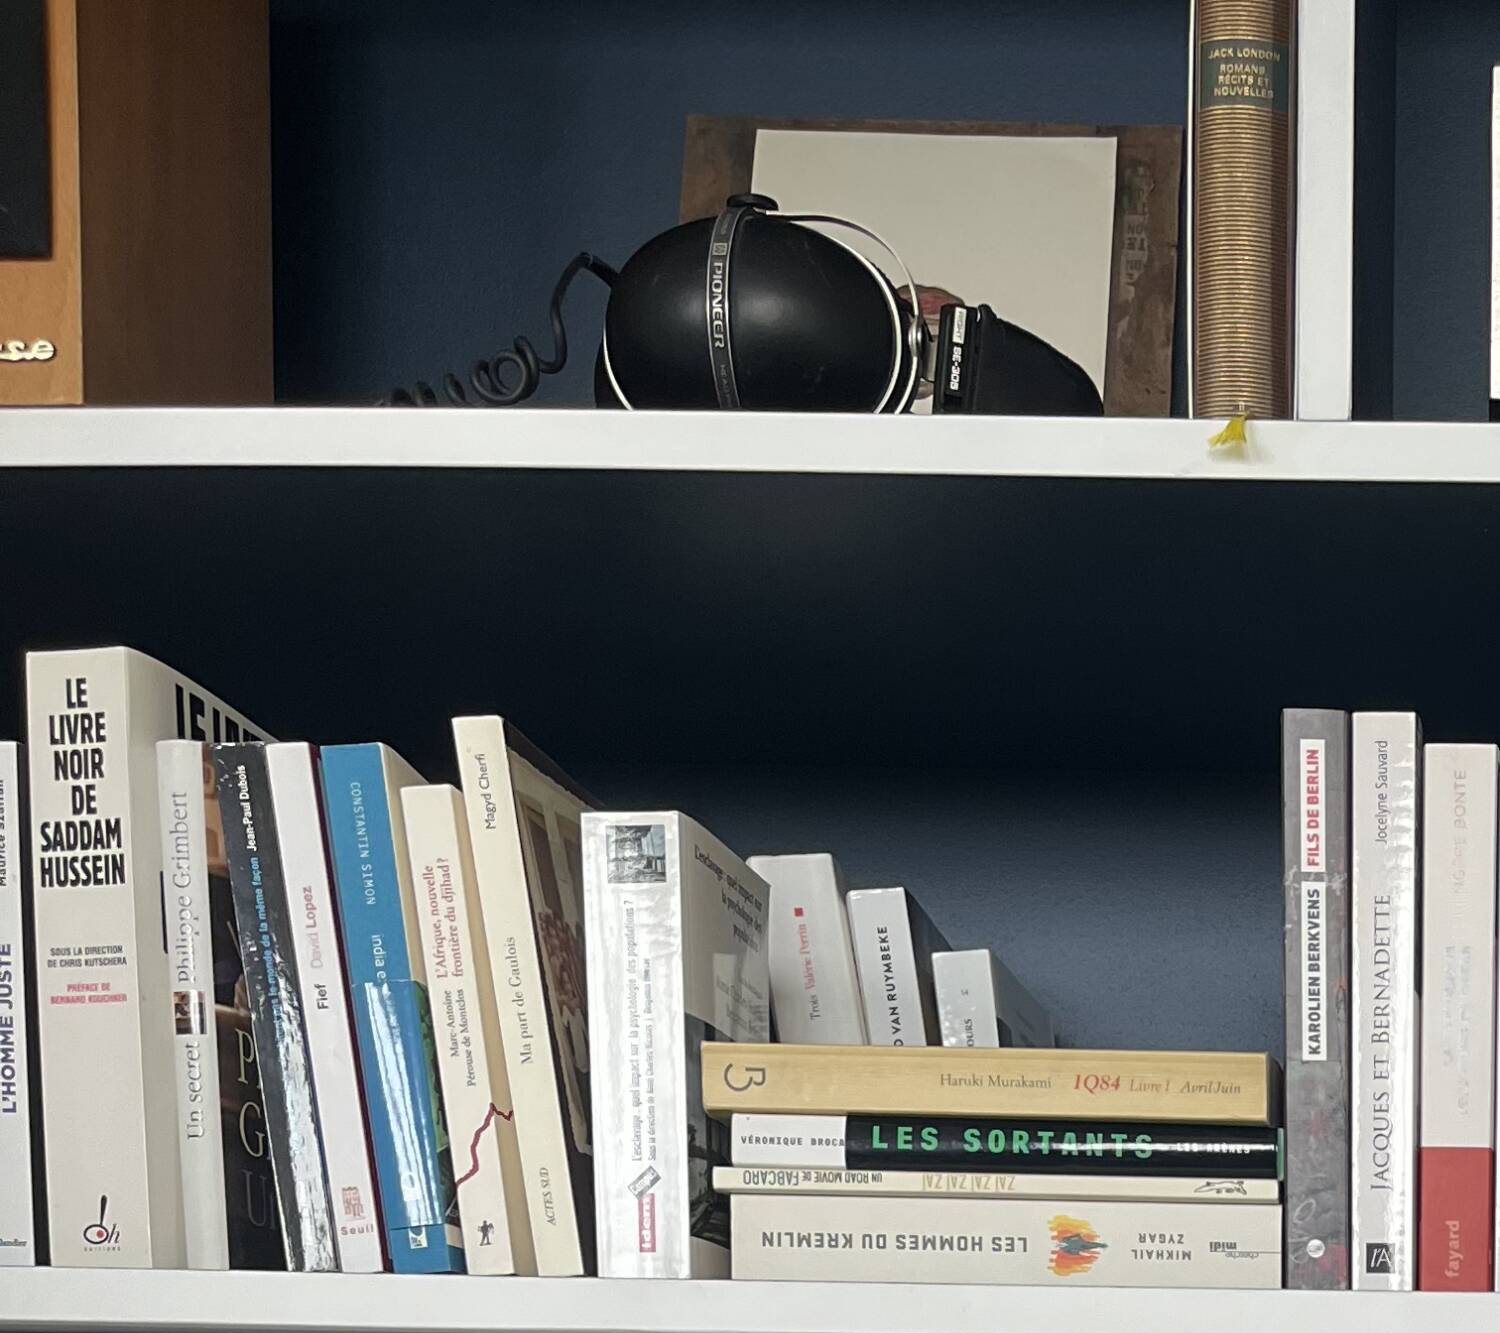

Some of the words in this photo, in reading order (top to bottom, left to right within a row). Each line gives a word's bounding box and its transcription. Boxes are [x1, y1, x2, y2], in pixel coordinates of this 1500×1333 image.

[1208, 48, 1233, 60] JACK
[1236, 48, 1280, 62] LONDON
[710, 261, 726, 349] PIONEER
[66, 677, 89, 710] LE
[49, 712, 107, 746] LIVRE
[53, 748, 105, 782] NOIR
[1305, 749, 1320, 805] BERLIN
[1374, 740, 1389, 794] Sauvard
[71, 784, 98, 816] DE
[236, 765, 251, 801] Dubois
[40, 817, 122, 853] SADDAM
[239, 802, 258, 851] Jean-Paul
[1374, 794, 1389, 845] Jocelyne
[169, 791, 193, 889] Grimbert
[351, 782, 370, 859] CONSTANTIN
[361, 863, 377, 905] SIMON
[1306, 832, 1320, 867] FILS
[40, 853, 126, 888] HUSSEIN
[301, 885, 318, 929] Lopez
[422, 865, 440, 916] nouvelle
[445, 922, 464, 977] frontière
[1306, 888, 1321, 976] BERKVENS
[877, 925, 898, 1002] RUYMBEKE
[1371, 895, 1392, 1044] BERNADETTE
[314, 983, 329, 1010] Fief
[1307, 979, 1322, 1055] KAROLIEN
[182, 1042, 204, 1103] secret
[940, 1074, 983, 1088] Haruki
[987, 1074, 1052, 1089] Murakami
[1373, 1055, 1390, 1081] ET
[187, 1109, 205, 1140] Un
[741, 1134, 804, 1146] VÉRONIQUE
[871, 1125, 940, 1151] LES
[963, 1128, 1154, 1159] SORTANTS
[1370, 1091, 1394, 1192] JACQUES
[742, 1170, 800, 1186] FABCARO
[340, 1224, 374, 1236] Seuil
[761, 1231, 853, 1249] KREMLIN
[861, 1232, 888, 1250] DU
[895, 1234, 984, 1252] HOMMES
[991, 1235, 1029, 1253] LES
[1138, 1232, 1185, 1244] ZYGAR
[1131, 1248, 1192, 1261] MIKHAIL
[1445, 1220, 1460, 1279] fayard
